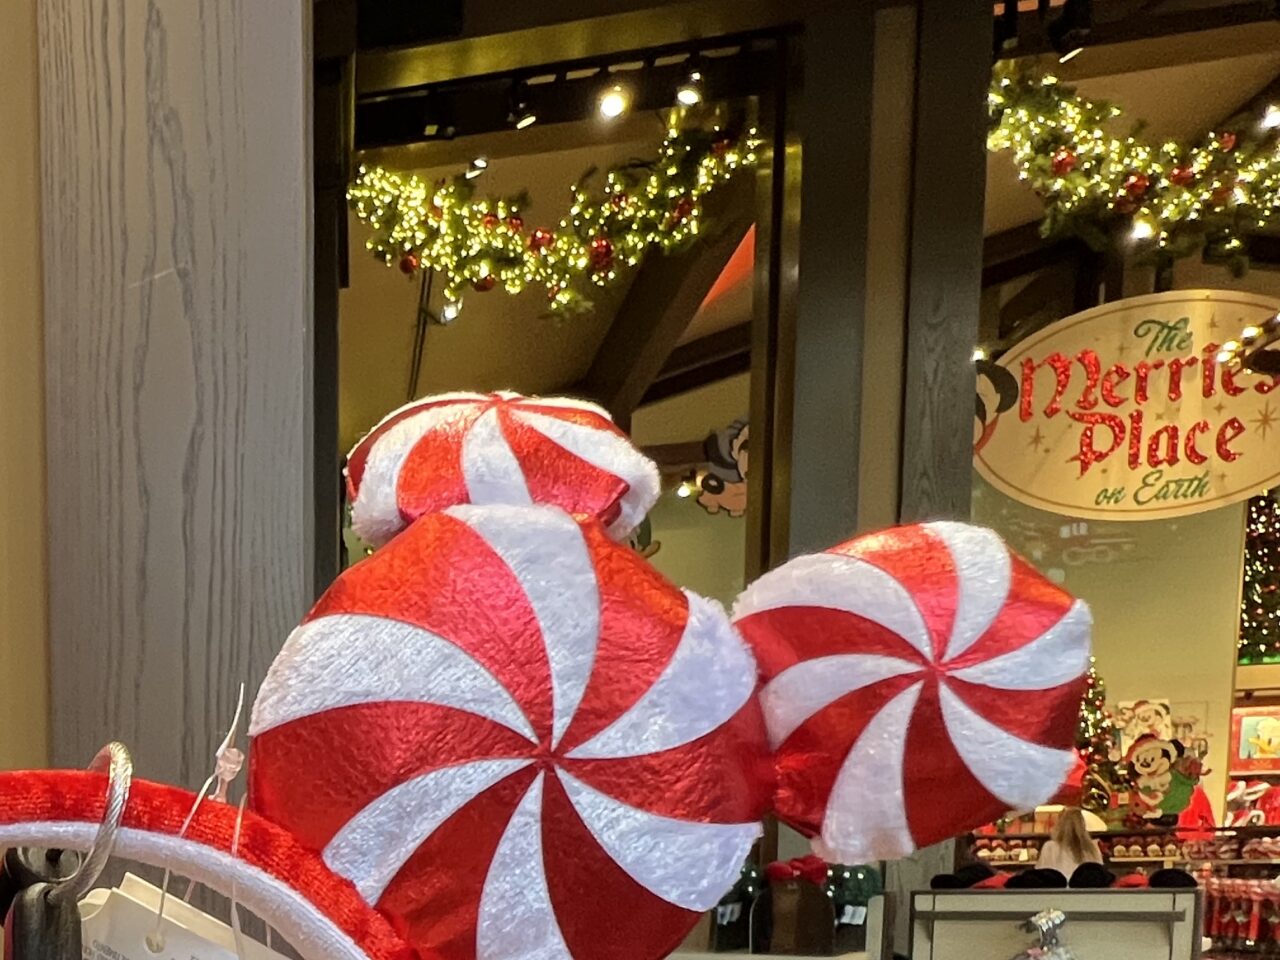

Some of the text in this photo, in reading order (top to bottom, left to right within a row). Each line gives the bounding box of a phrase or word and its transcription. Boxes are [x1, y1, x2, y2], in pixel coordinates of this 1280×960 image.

[1134, 316, 1193, 357] The
[1066, 408, 1246, 479] Place
[1095, 469, 1210, 506] on Earth
